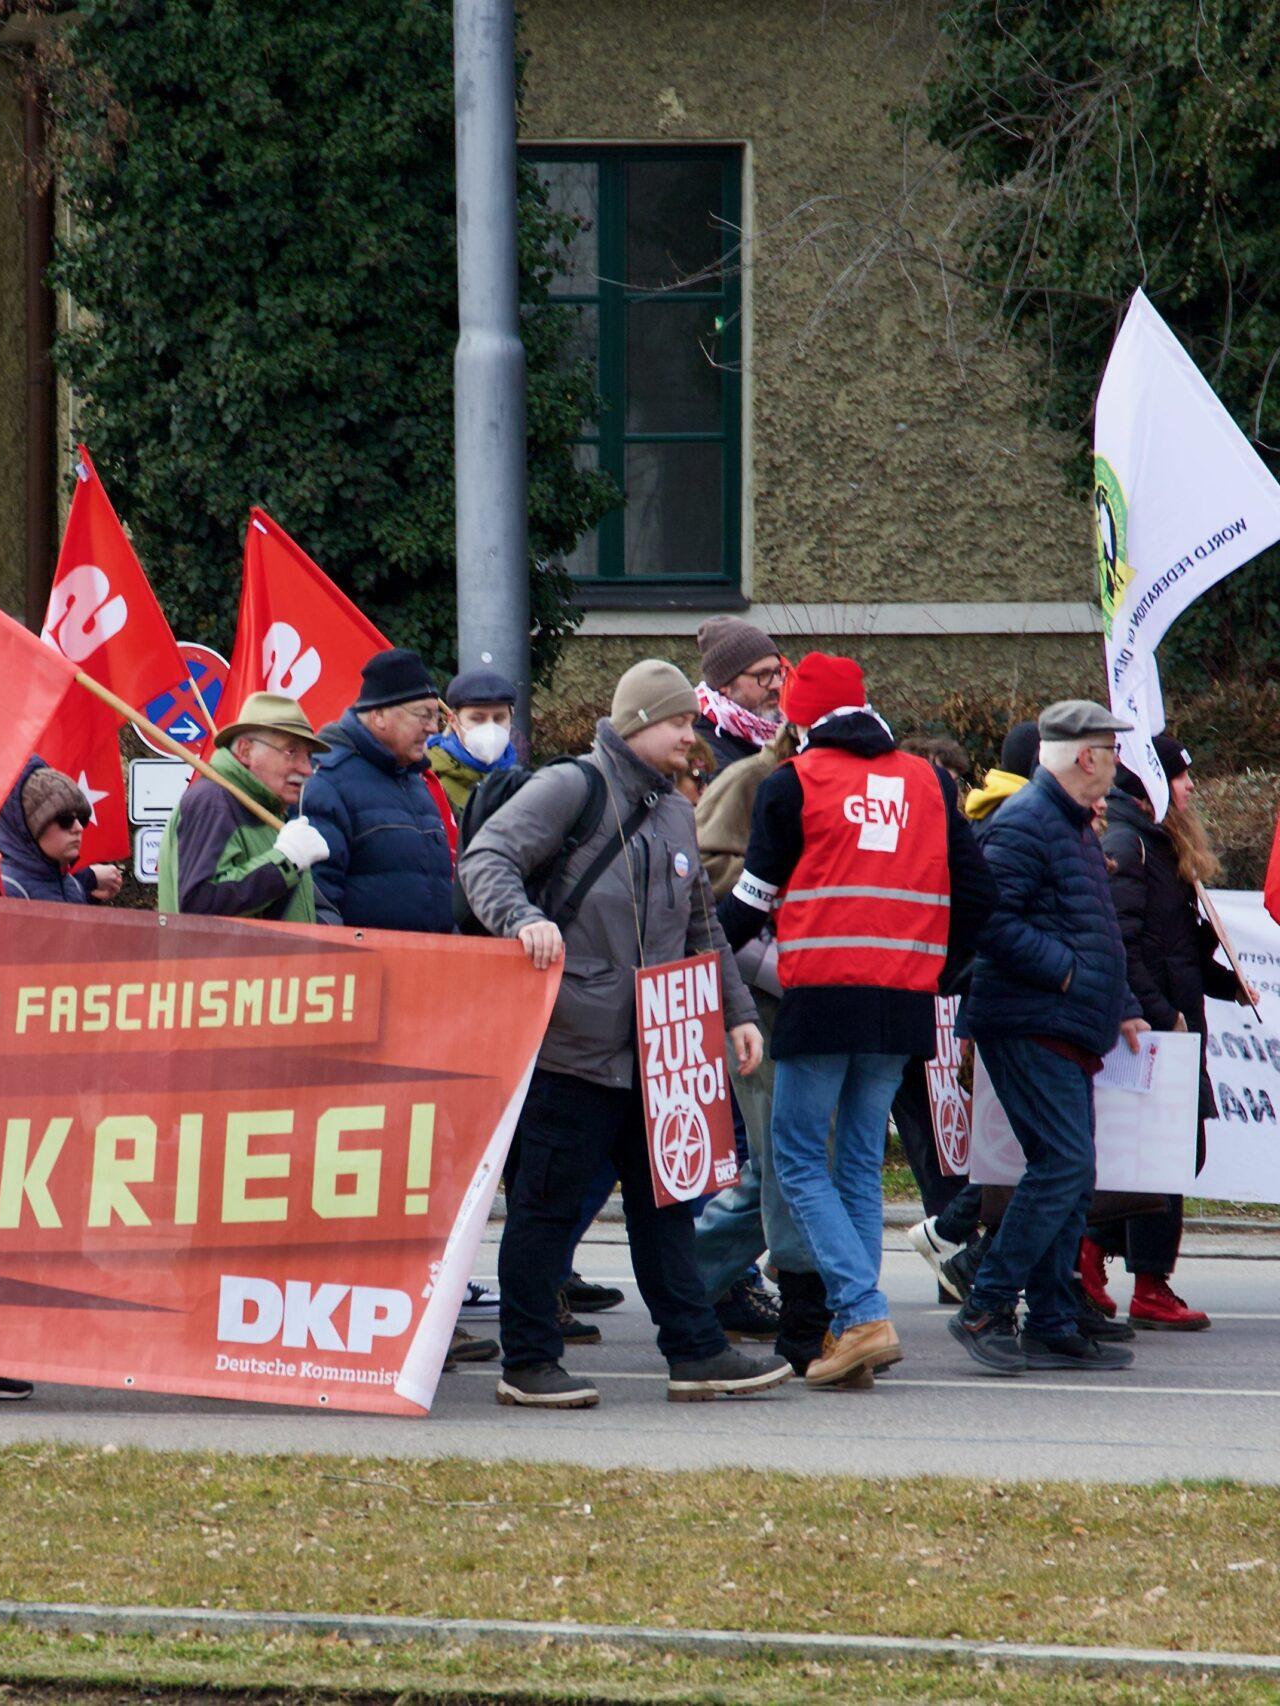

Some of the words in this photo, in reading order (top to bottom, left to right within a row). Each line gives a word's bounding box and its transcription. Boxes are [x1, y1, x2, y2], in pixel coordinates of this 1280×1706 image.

[843, 793, 909, 831] GEW
[15, 973, 358, 1036] FASCHISMUS!
[640, 960, 720, 1029] NEIN
[643, 1019, 708, 1078] ZUR
[928, 1026, 963, 1068] UR
[647, 1057, 726, 1118] NATO!
[217, 1274, 413, 1355] DKP
[215, 1353, 297, 1378] Deutsche
[299, 1361, 401, 1386] Kommunist
